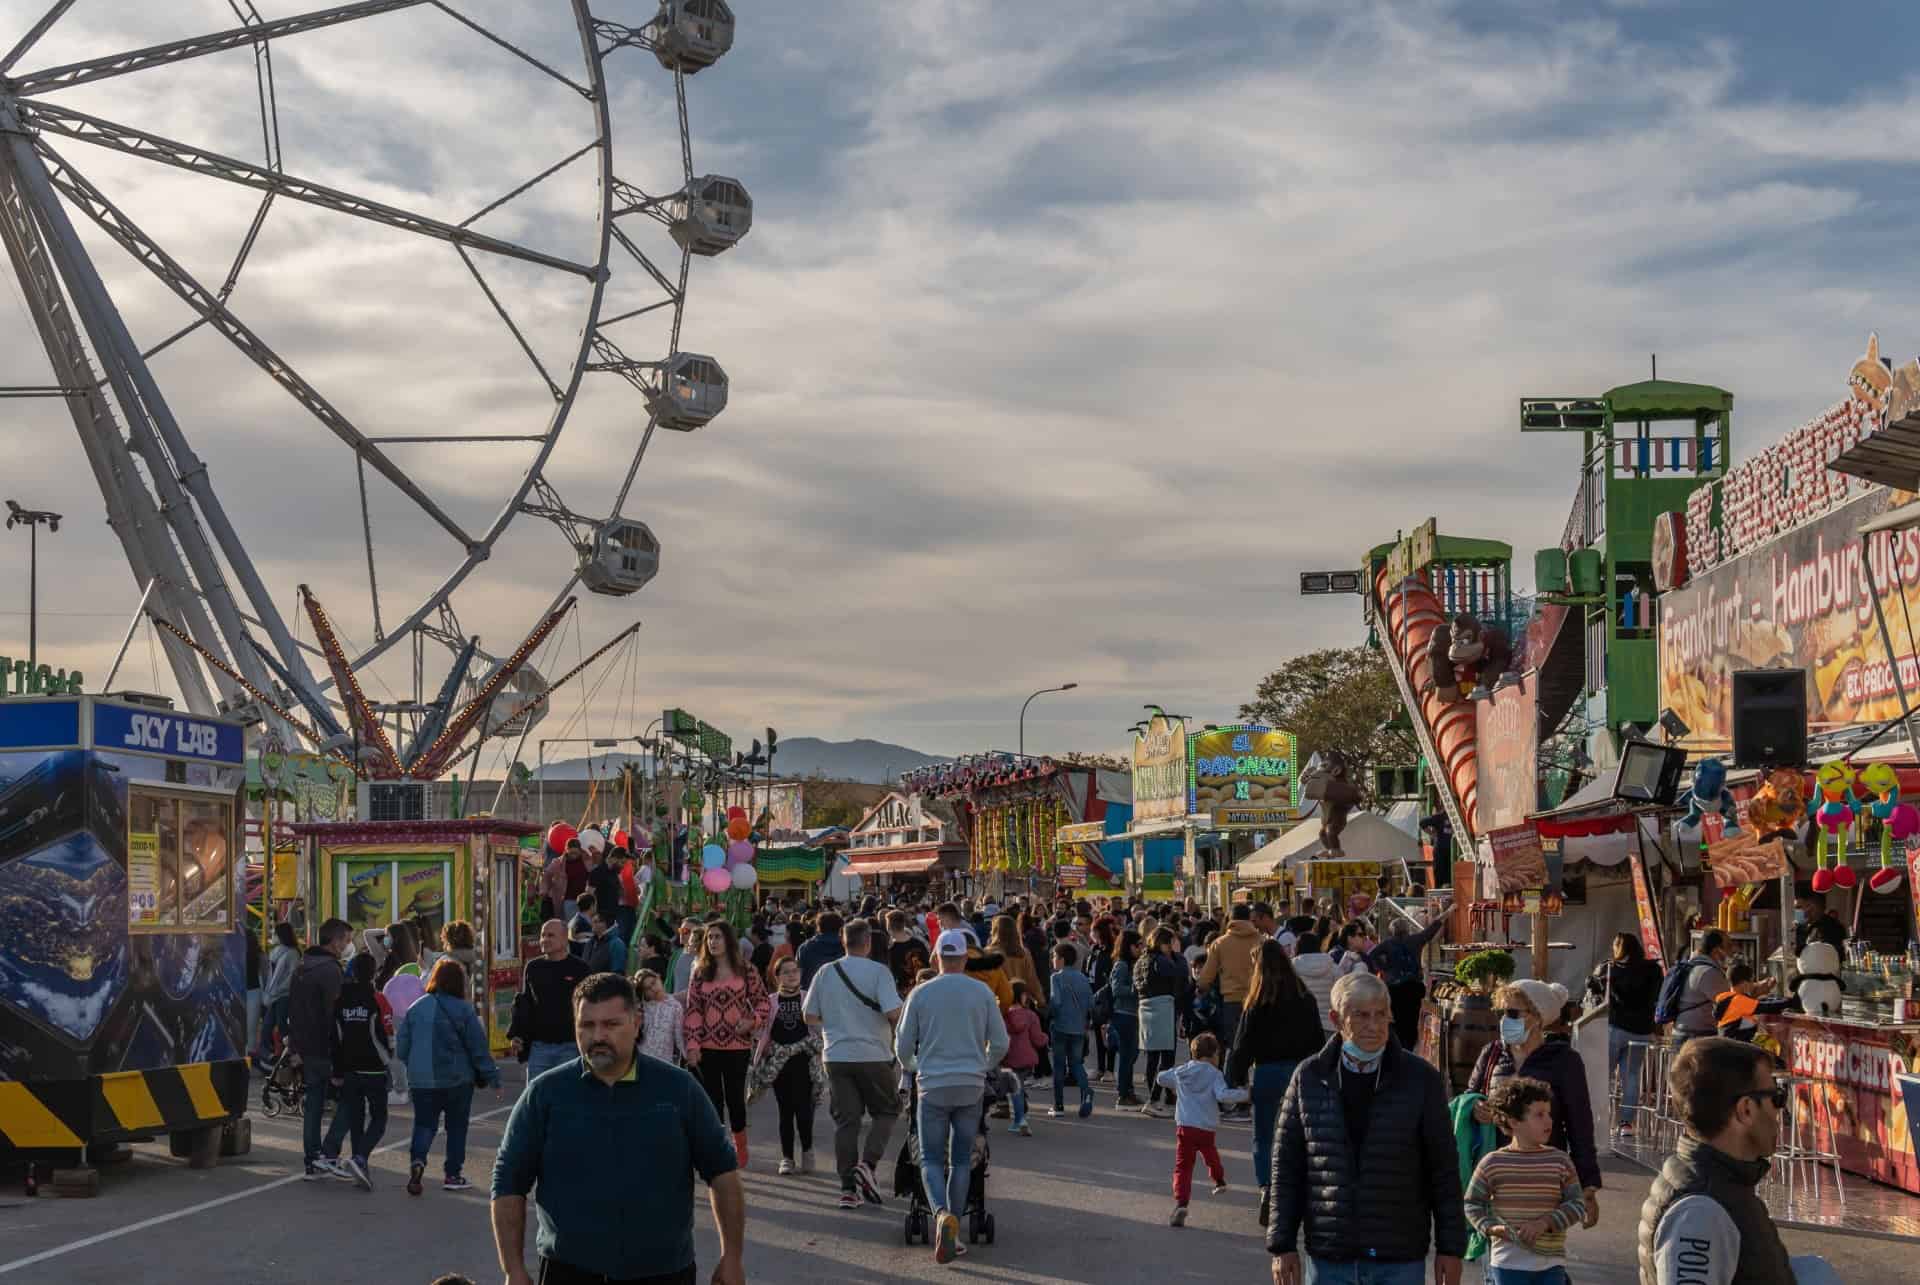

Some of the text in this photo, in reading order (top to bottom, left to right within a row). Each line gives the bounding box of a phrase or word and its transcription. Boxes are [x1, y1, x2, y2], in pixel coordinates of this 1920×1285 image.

[1663, 580, 1743, 668] Frankfurt
[124, 714, 217, 757] SKY LAB
